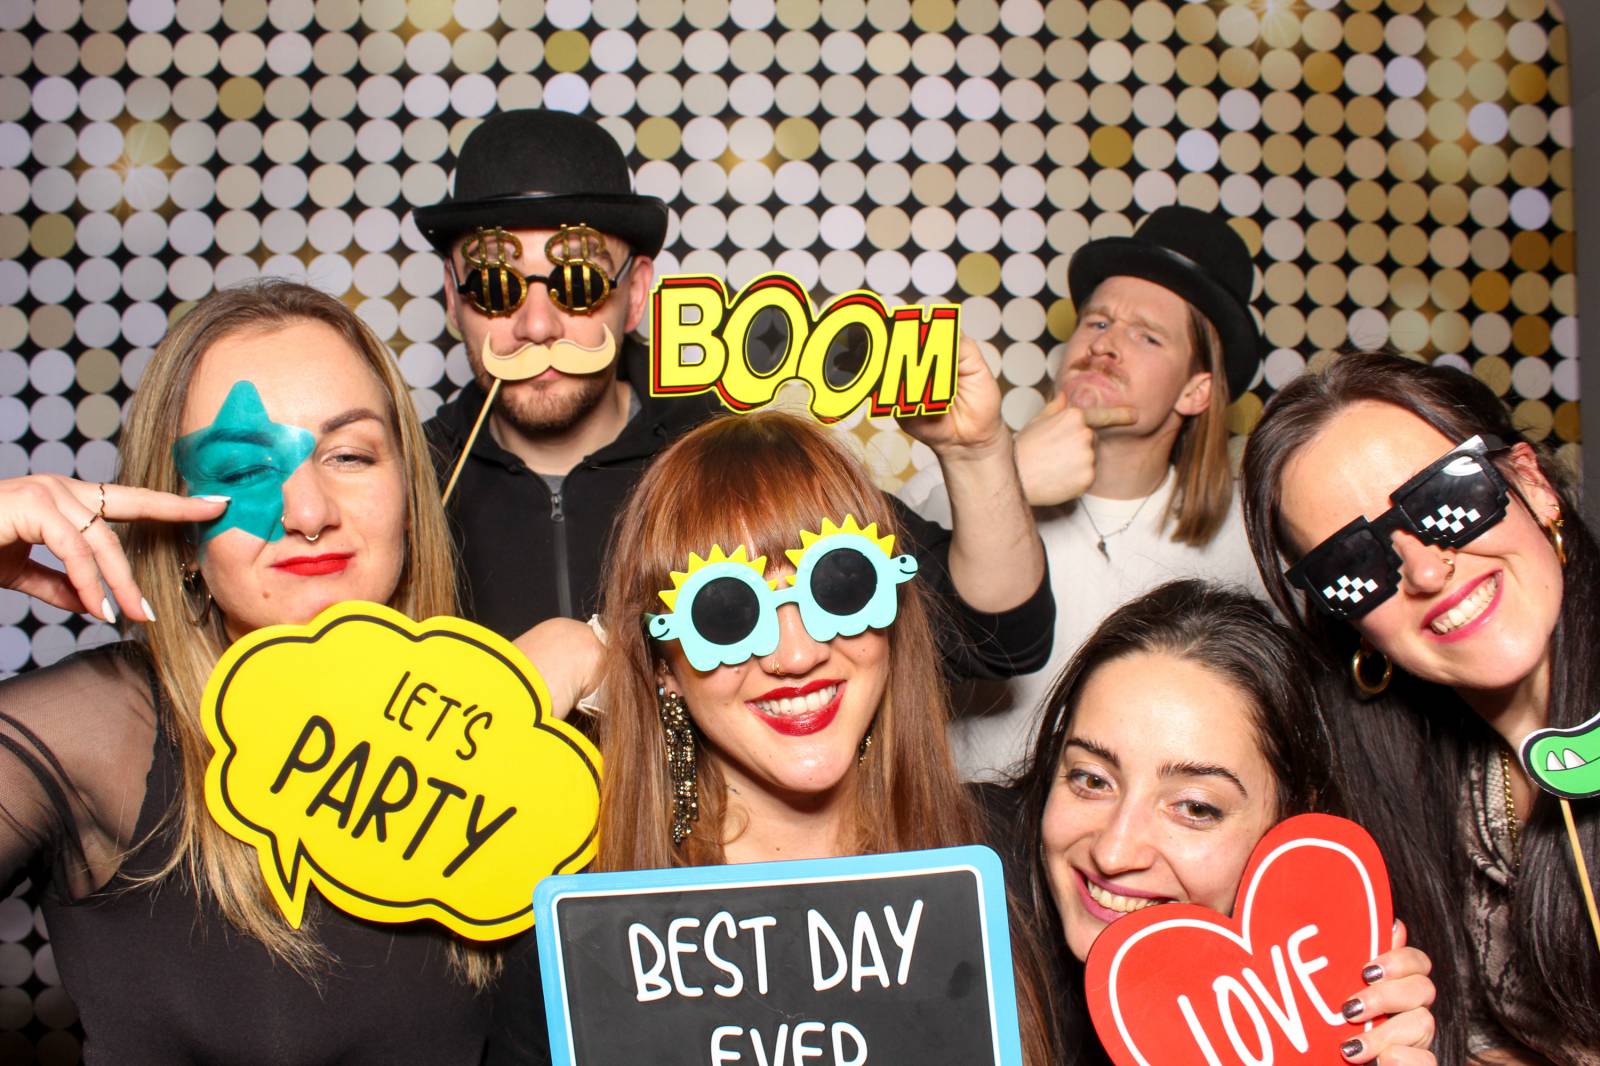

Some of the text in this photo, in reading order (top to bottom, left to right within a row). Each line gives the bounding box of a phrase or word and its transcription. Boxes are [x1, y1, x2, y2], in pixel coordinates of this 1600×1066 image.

[651, 273, 959, 424] BOOM
[384, 671, 493, 761] LET'S
[269, 715, 518, 878] PARTY
[628, 899, 924, 1002] BEST DAY
